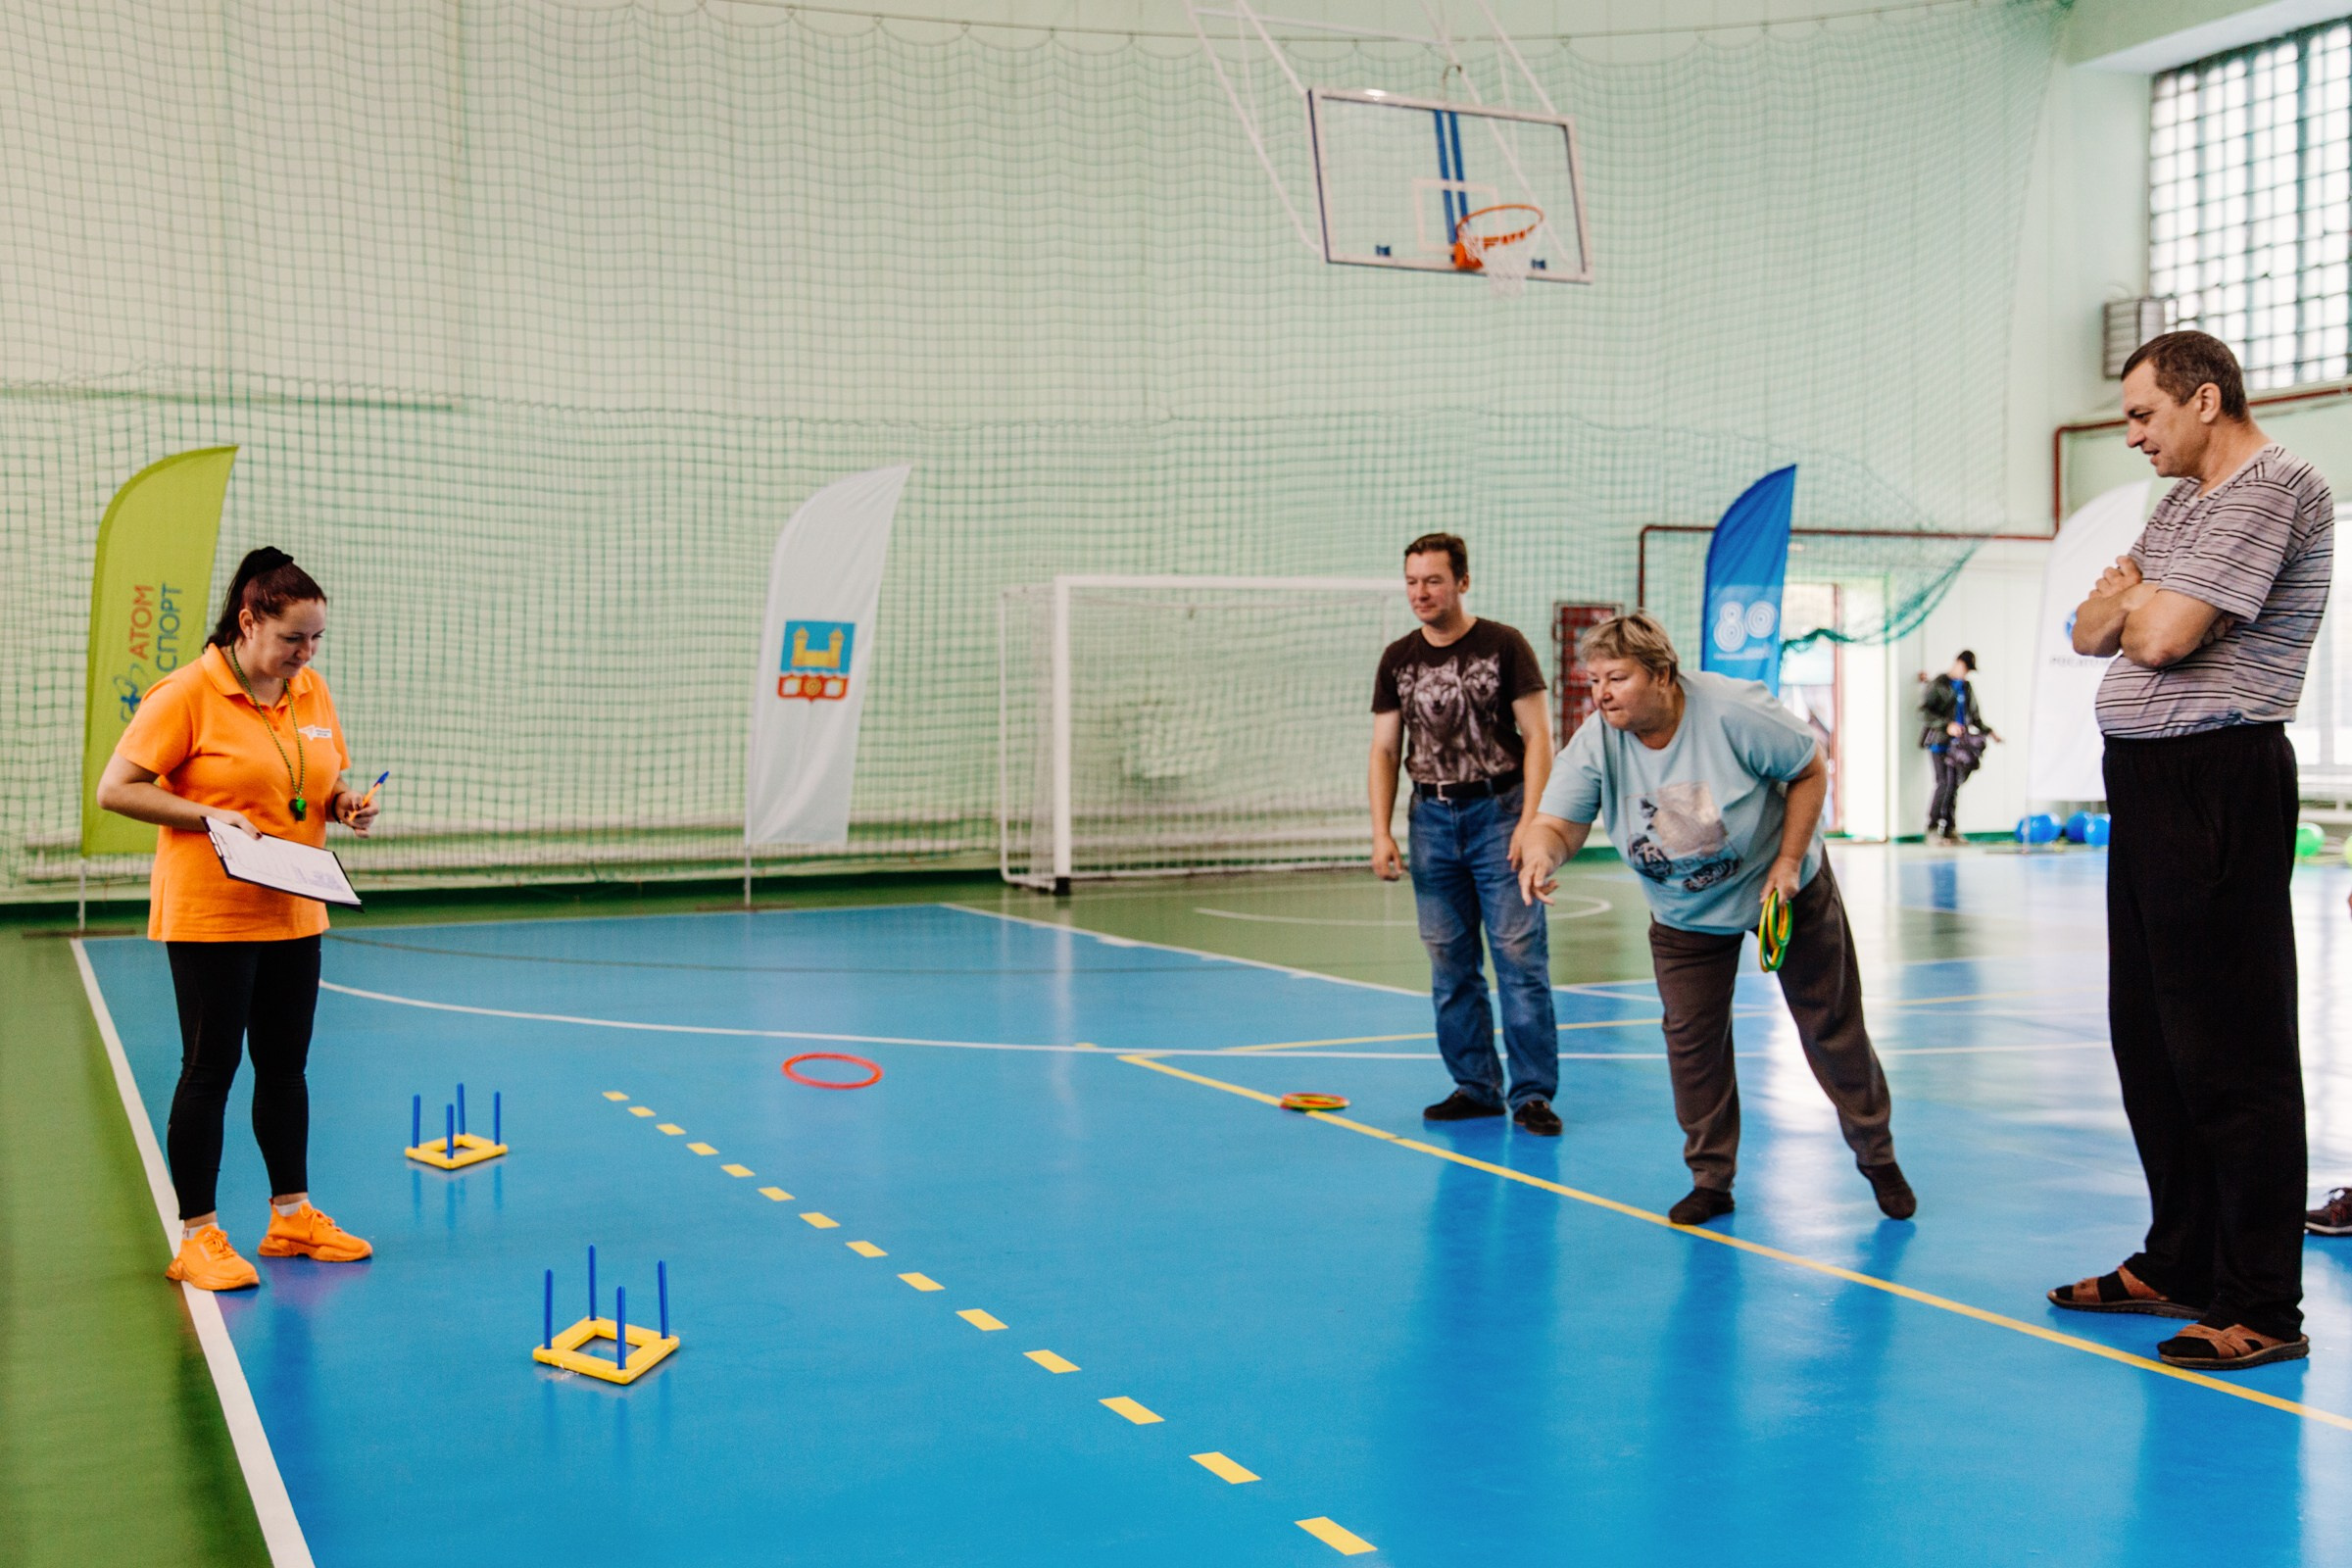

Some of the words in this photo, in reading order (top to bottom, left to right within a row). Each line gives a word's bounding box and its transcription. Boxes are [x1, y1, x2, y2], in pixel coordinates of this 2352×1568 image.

[128, 584, 155, 661] АТОМ
[155, 580, 182, 672] СПОРТ
[1713, 600, 1779, 653] 80
